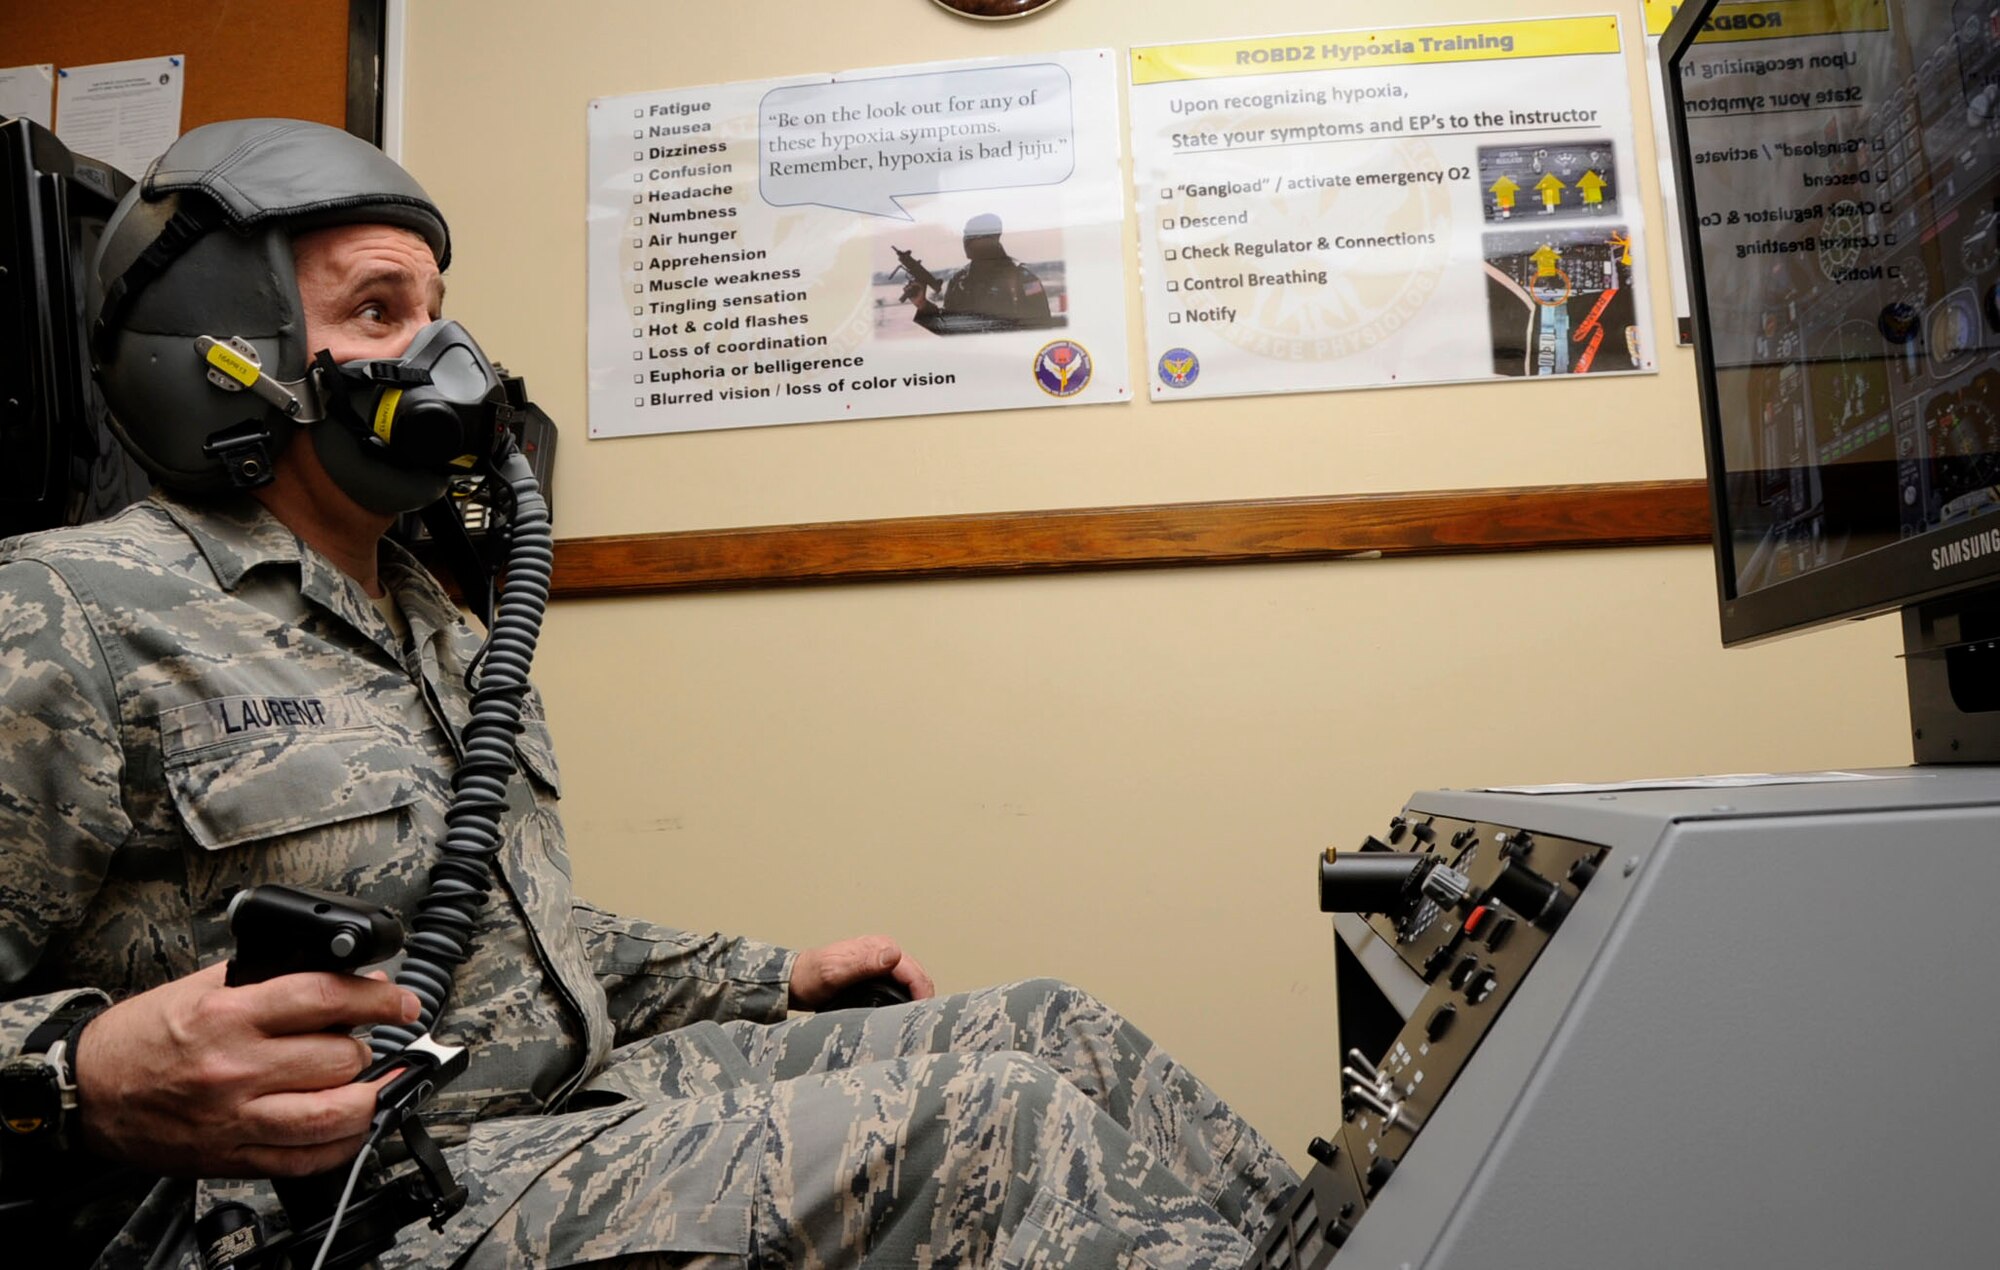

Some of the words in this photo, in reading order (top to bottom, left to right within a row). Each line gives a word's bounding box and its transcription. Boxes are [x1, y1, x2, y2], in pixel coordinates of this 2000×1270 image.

[1236, 46, 1315, 65] ROBD2
[1322, 39, 1415, 61] Hypoxia
[1418, 34, 1514, 52] Training
[650, 102, 711, 117] Fatigue
[804, 114, 826, 125] on
[832, 106, 861, 122] the
[867, 101, 906, 119] look
[912, 102, 942, 115] out
[949, 96, 974, 112] for
[980, 97, 1012, 111] any
[1018, 89, 1037, 106] of
[1170, 99, 1218, 115] Upon
[1224, 89, 1327, 109] recognizing
[1332, 83, 1408, 104] hypoxia,
[649, 123, 711, 138] Nausea
[769, 136, 815, 152] these
[822, 131, 895, 151] hypoxia
[900, 124, 1000, 145] symptoms.
[1172, 133, 1217, 148] State
[1224, 130, 1264, 147] your
[1270, 123, 1364, 142] symptoms
[1370, 116, 1403, 133] and
[1449, 115, 1469, 129] to
[1473, 111, 1504, 127] the
[1509, 109, 1597, 125] instructor
[649, 142, 727, 160] Dizziness
[770, 154, 873, 177] Remember,
[878, 148, 953, 171] hypoxia
[959, 146, 973, 161] is
[979, 140, 1012, 159] bad
[649, 163, 732, 181] Confusion
[1275, 176, 1282, 193] /
[1288, 175, 1351, 189] activate
[1355, 171, 1444, 187] emergency
[1448, 166, 1471, 181] O2
[648, 184, 733, 202] Headache
[649, 207, 737, 225] Numbness
[1180, 210, 1247, 229] Descend
[648, 234, 673, 247] Air
[678, 230, 738, 244] hunger
[1181, 243, 1230, 259] Check
[1234, 239, 1313, 258] Regulator
[1317, 237, 1330, 250] &
[1335, 232, 1435, 249] Connections
[649, 249, 766, 272] Apprehension
[649, 276, 708, 292] Muscle
[714, 269, 801, 286] weakness
[1184, 273, 1244, 291] Control
[1248, 269, 1328, 287] Breathing
[649, 298, 716, 315] Tingling
[723, 290, 807, 307] sensation
[1186, 306, 1236, 323] Notify
[649, 323, 678, 337] Hot
[684, 321, 697, 333] &
[703, 317, 739, 331] cold
[745, 313, 809, 328] flashes
[649, 347, 688, 359] Loss
[694, 342, 710, 356] of
[717, 334, 827, 354] coordination
[650, 365, 725, 384] Euphoria
[731, 366, 749, 376] or
[754, 357, 864, 374] belligerence
[650, 389, 713, 406] Blurred
[719, 386, 770, 400] vision
[776, 384, 780, 397] /
[786, 383, 822, 395] loss
[828, 378, 845, 392] of
[851, 376, 897, 391] color
[902, 372, 955, 387] vision
[1931, 528, 2000, 571] SAMSUNG
[220, 698, 326, 734] LAURENT
